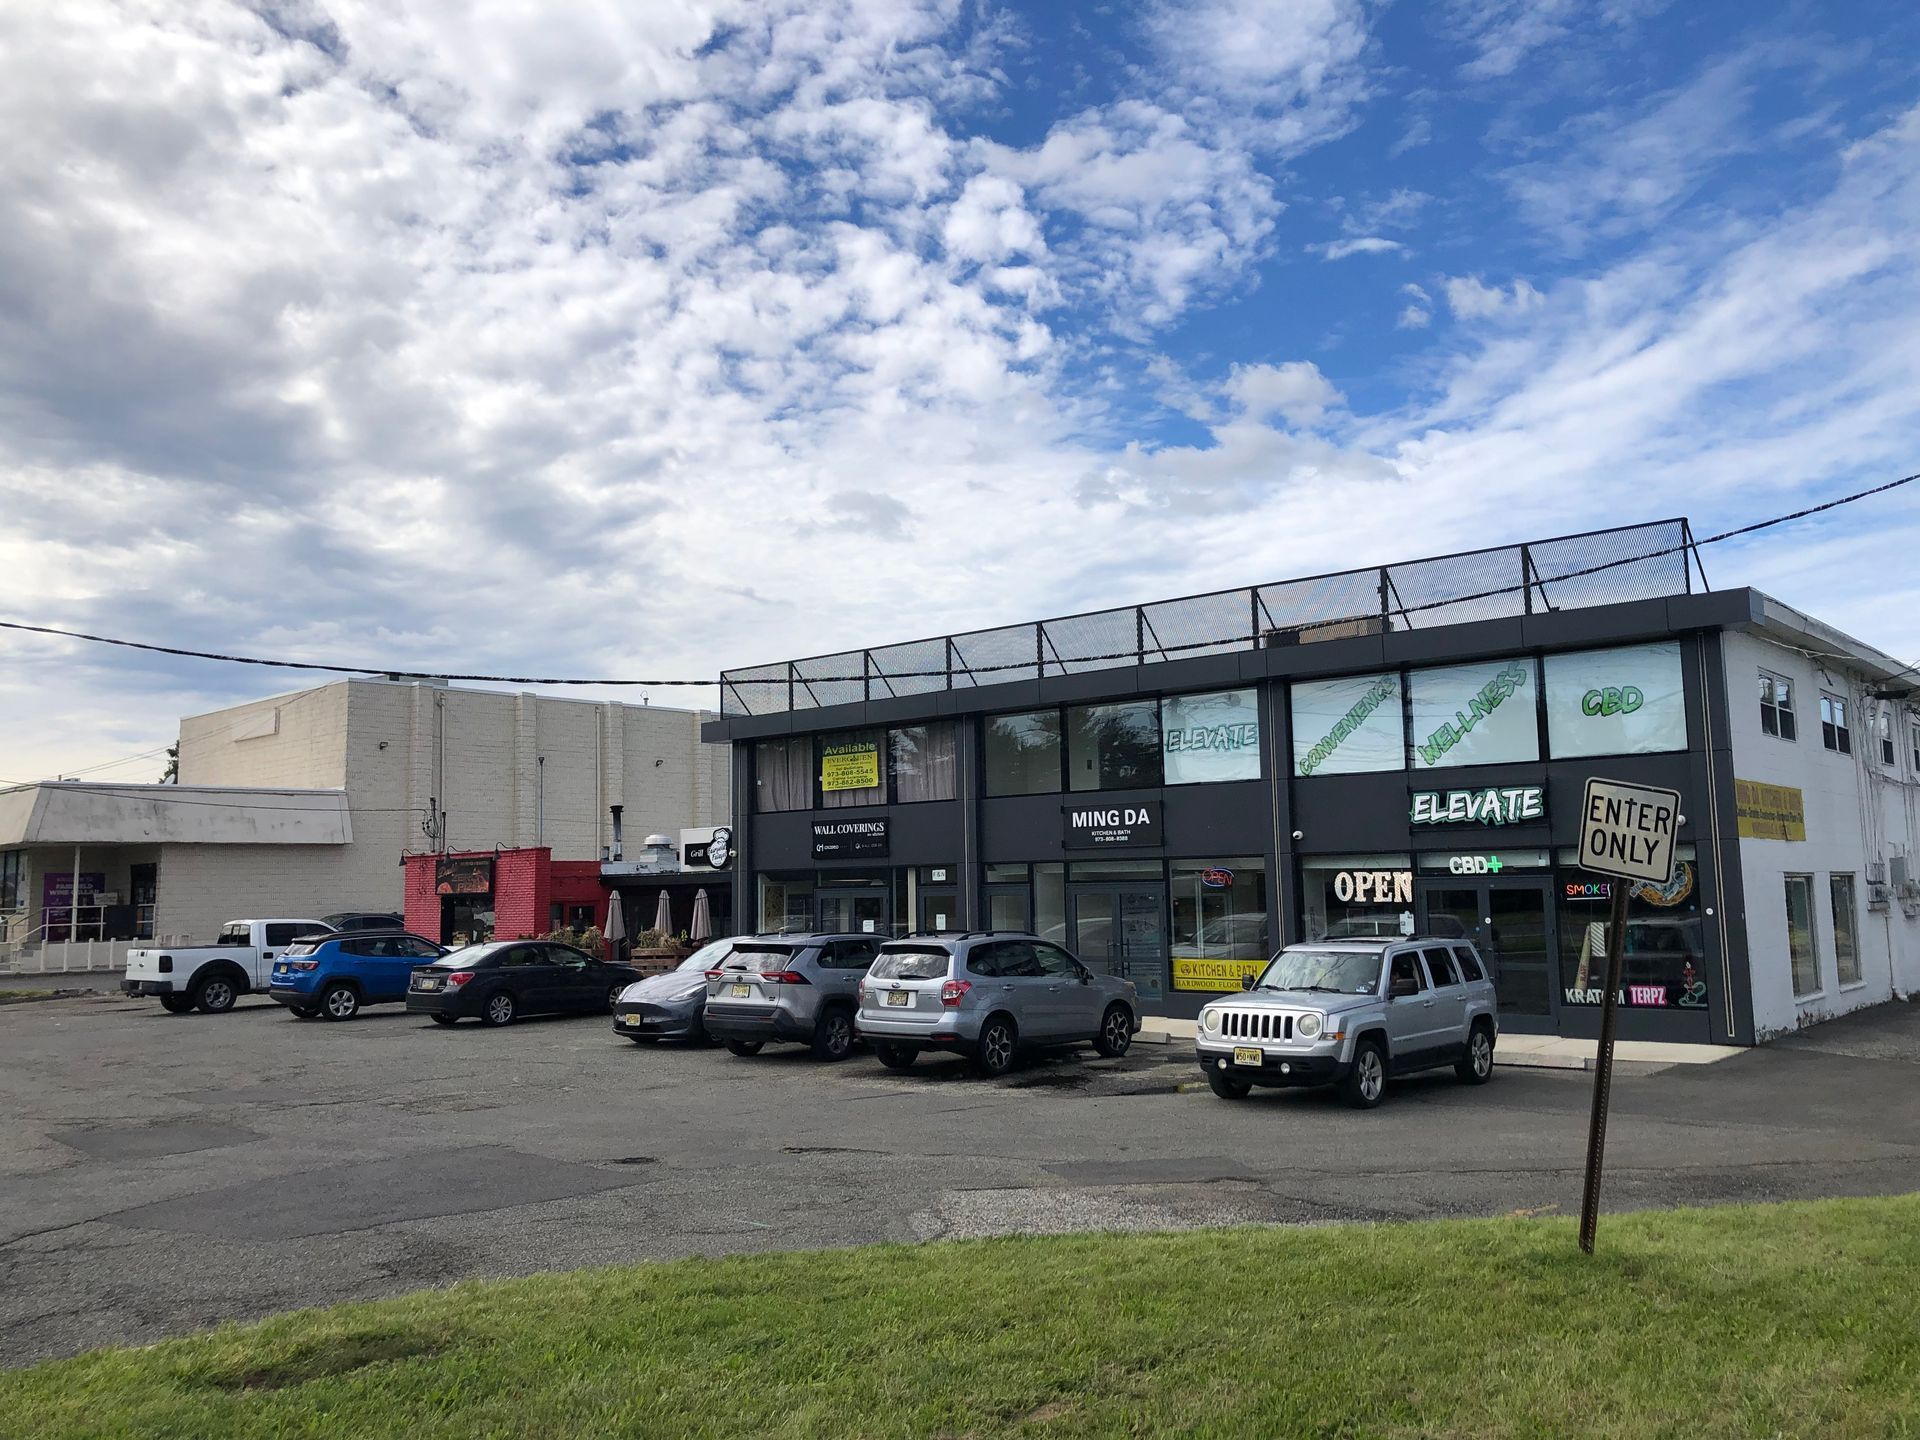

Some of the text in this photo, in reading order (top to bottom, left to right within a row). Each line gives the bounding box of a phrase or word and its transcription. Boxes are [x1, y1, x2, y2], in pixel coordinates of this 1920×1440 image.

[1582, 686, 1643, 717] CBD
[1417, 662, 1527, 766] WELLNESS
[1167, 724, 1257, 752] ELEVATE
[1300, 677, 1397, 777] CONVENIENCE
[824, 742, 876, 755] Available
[1412, 788, 1542, 823] ELEVATE
[1589, 795, 1671, 835] ENTER
[814, 822, 885, 836] WALL COVERINGS
[1072, 808, 1150, 828] MING DA
[690, 849, 704, 858] Grill
[1590, 828, 1660, 866] ONLY
[1203, 868, 1232, 886] OPEN
[1334, 871, 1413, 903] OPEN
[1192, 963, 1258, 978] KITCHEN & BATH
[1175, 979, 1216, 987] HARDWOOD
[1565, 987, 1667, 1005] KRATM TERPZ
